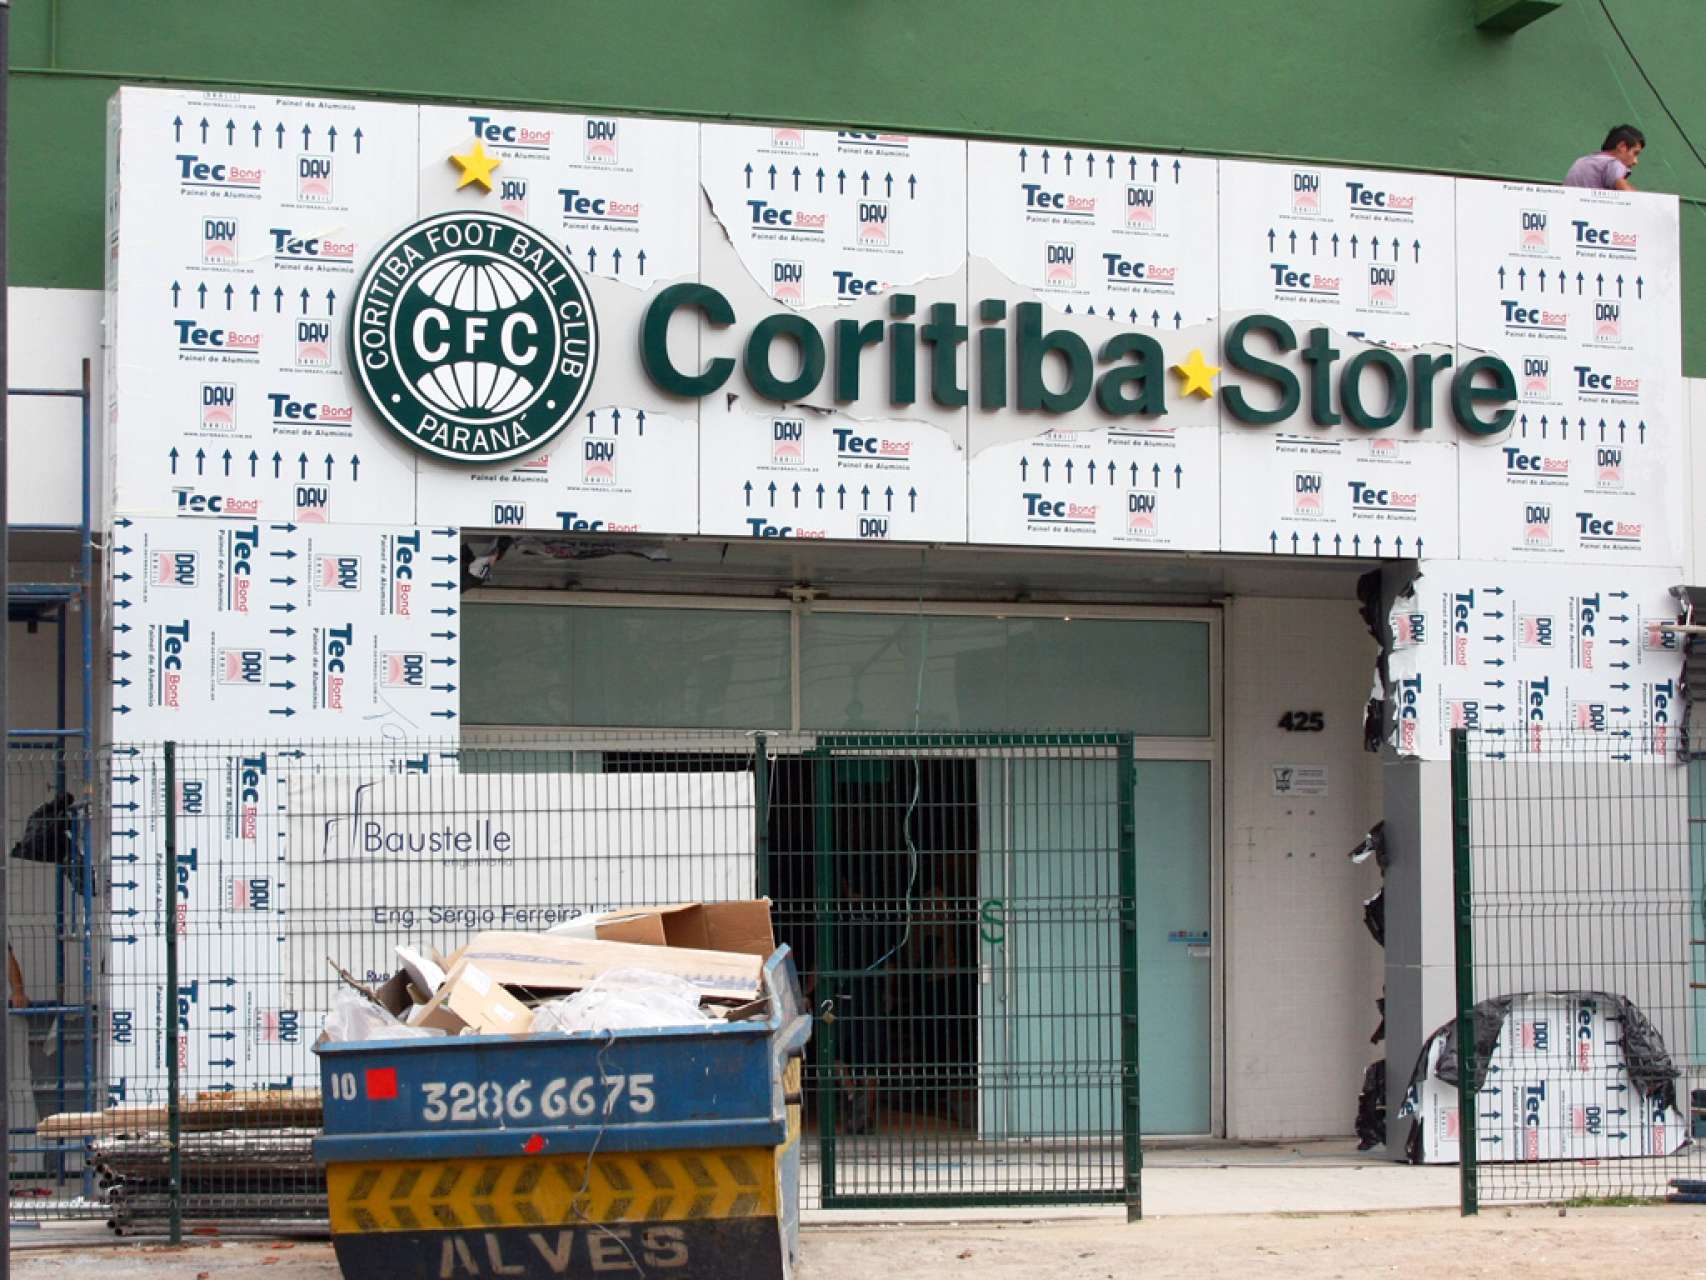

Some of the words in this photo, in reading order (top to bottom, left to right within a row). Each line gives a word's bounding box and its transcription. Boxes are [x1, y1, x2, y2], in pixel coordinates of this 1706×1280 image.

[469, 116, 516, 142] Tec
[521, 129, 550, 140] Bond
[588, 120, 615, 140] DAY
[176, 155, 225, 180] Tec
[230, 168, 261, 178] Bond
[300, 159, 330, 178] DAY
[1295, 175, 1318, 192] DAY
[1346, 182, 1385, 206] Tec
[1389, 195, 1413, 205] Bond
[558, 190, 605, 214] Tec
[610, 202, 639, 213] Bond
[1022, 184, 1064, 209] Tec
[1068, 196, 1095, 208] Bond
[1128, 188, 1153, 207] DAY
[747, 200, 792, 225] Tec
[796, 212, 825, 223] Bond
[860, 204, 887, 223] DAY
[1523, 213, 1546, 230] DAY
[205, 221, 235, 240] DAY
[270, 228, 318, 255] Tec
[324, 241, 353, 253] Bond
[1572, 220, 1609, 243] Tec
[1613, 232, 1637, 242] Bond
[1048, 245, 1073, 264] DAY
[1103, 253, 1144, 278] Tec
[1148, 265, 1175, 276] Bond
[775, 263, 801, 282] DAY
[833, 272, 879, 295] Tec
[1271, 264, 1310, 288] Tec
[1314, 276, 1339, 286] Bond
[1371, 268, 1395, 286] DAY
[363, 243, 425, 369] CORITIBA
[425, 223, 503, 253] FOOT
[509, 234, 567, 296] BALL
[559, 301, 587, 378] CLUB
[1501, 300, 1538, 323] Tec
[1542, 312, 1566, 321] Bond
[1596, 304, 1618, 321] DAY
[174, 320, 223, 346] Tec
[229, 332, 259, 344] Bond
[298, 323, 328, 342] DAY
[641, 283, 1167, 416] Coritiba
[1221, 314, 1517, 435] Store
[1525, 360, 1548, 377] DAY
[1574, 367, 1611, 389] Tec
[1616, 377, 1638, 388] Bond
[203, 387, 233, 406] DAY
[268, 393, 316, 419] Tec
[322, 405, 352, 417] Bond
[416, 413, 531, 452] PARANÁ
[775, 422, 802, 441] DAY
[833, 428, 877, 453] Tec
[882, 441, 910, 451] Bond
[585, 442, 614, 461] DAY
[1503, 448, 1540, 470] Tec
[1544, 458, 1568, 467] Bond
[1598, 450, 1621, 466] DAY
[1296, 475, 1320, 493] DAY
[1348, 482, 1388, 505] Tec
[1391, 492, 1416, 502] Bond
[297, 488, 327, 507] DAY
[1023, 493, 1065, 517] Tec
[1069, 504, 1096, 515] Bond
[1129, 495, 1155, 513] DAY
[495, 506, 524, 525] DAY
[556, 512, 603, 533] Tec
[1526, 507, 1550, 523] DAY
[1576, 513, 1613, 535] Tec
[1618, 522, 1641, 532] Bond
[747, 518, 792, 538] Tec
[860, 519, 887, 537] DAY
[235, 525, 258, 576] Tec
[396, 530, 420, 579] Tec
[175, 553, 195, 586] DAY
[338, 558, 358, 589] DAY
[240, 579, 249, 612] Bond
[401, 584, 411, 616] Bond
[1456, 589, 1474, 633] Tec
[1581, 593, 1599, 636] Tec
[1409, 614, 1425, 642] DAY
[1536, 618, 1551, 645] DAY
[165, 620, 189, 670] Tec
[328, 623, 352, 674] Tec
[1460, 638, 1468, 665] Bond
[243, 652, 262, 683] DAY
[405, 655, 424, 686] DAY
[169, 674, 180, 707] Bond
[333, 677, 343, 710] Bond
[1403, 673, 1421, 719] Tec
[1531, 676, 1548, 720] Tec
[1655, 679, 1673, 723] Tec
[1278, 711, 1324, 731] 425
[243, 752, 267, 803] Tec
[183, 782, 202, 814] DAY
[247, 807, 256, 838] Bond
[365, 819, 510, 852] Baustelle
[250, 879, 269, 910] DAY
[374, 907, 419, 927] Eng.
[112, 1011, 131, 1043] DAY
[280, 1011, 298, 1041] DAY
[332, 1073, 357, 1099] 10
[1527, 1080, 1545, 1126] Tec
[1652, 1097, 1664, 1122] ec
[440, 1226, 689, 1279] ALVES
